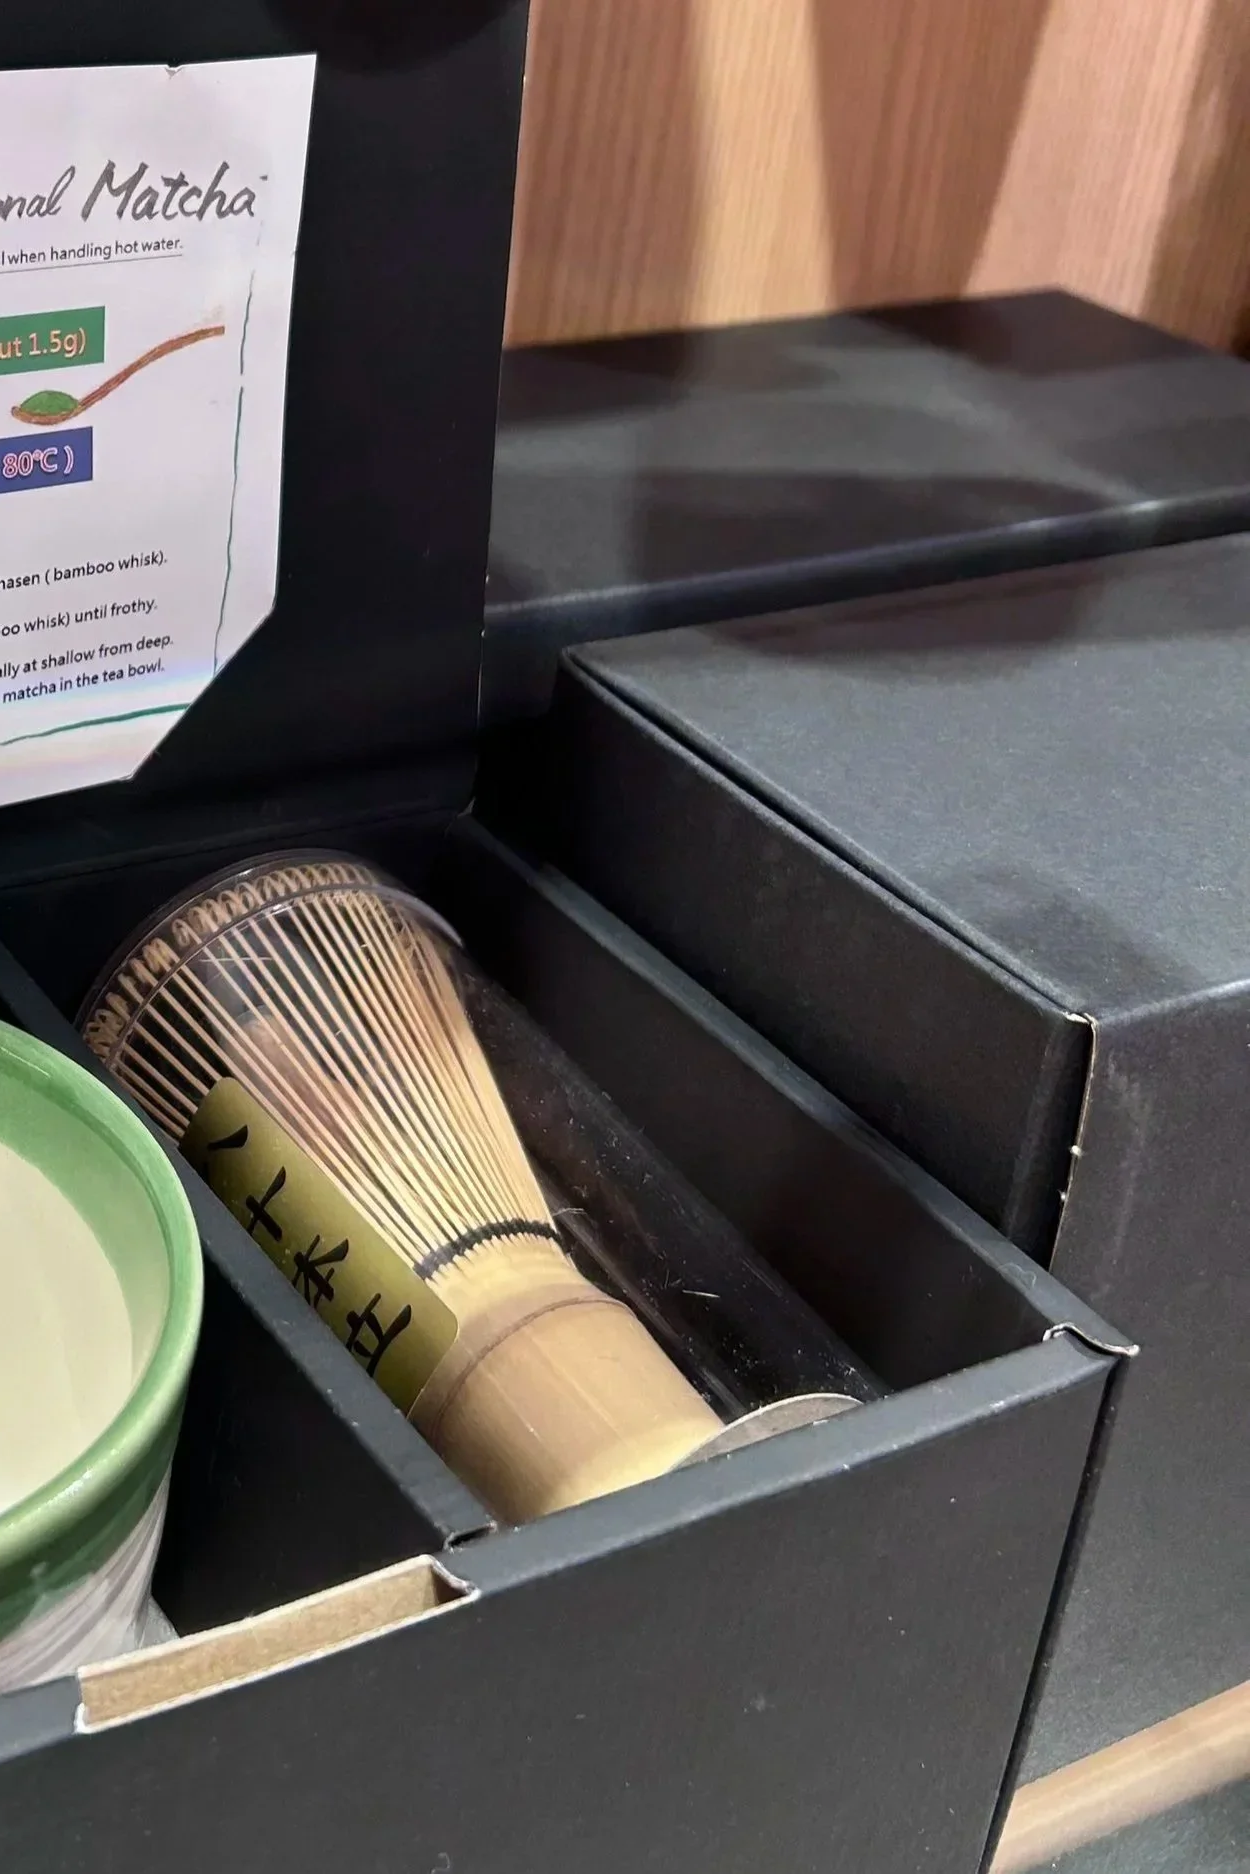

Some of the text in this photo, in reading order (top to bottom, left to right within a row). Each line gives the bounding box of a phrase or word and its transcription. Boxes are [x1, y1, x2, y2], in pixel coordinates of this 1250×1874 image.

[81, 159, 256, 222] Matcha
[7, 246, 46, 265] when
[50, 241, 112, 262] handling
[115, 239, 139, 255] hot
[141, 236, 184, 253] water.
[27, 327, 86, 360] 1.5g)
[118, 551, 168, 570] whisk).
[24, 611, 70, 632] whisk)
[74, 606, 107, 623] until
[111, 598, 157, 618] frothy.
[23, 660, 38, 673] at
[41, 648, 95, 670] shallow
[98, 640, 132, 658] from
[136, 634, 173, 653] deep.
[3, 683, 56, 704] matcha
[60, 677, 72, 691] in
[76, 673, 98, 688] the
[102, 669, 124, 682] tea
[128, 658, 165, 678] bowl.
